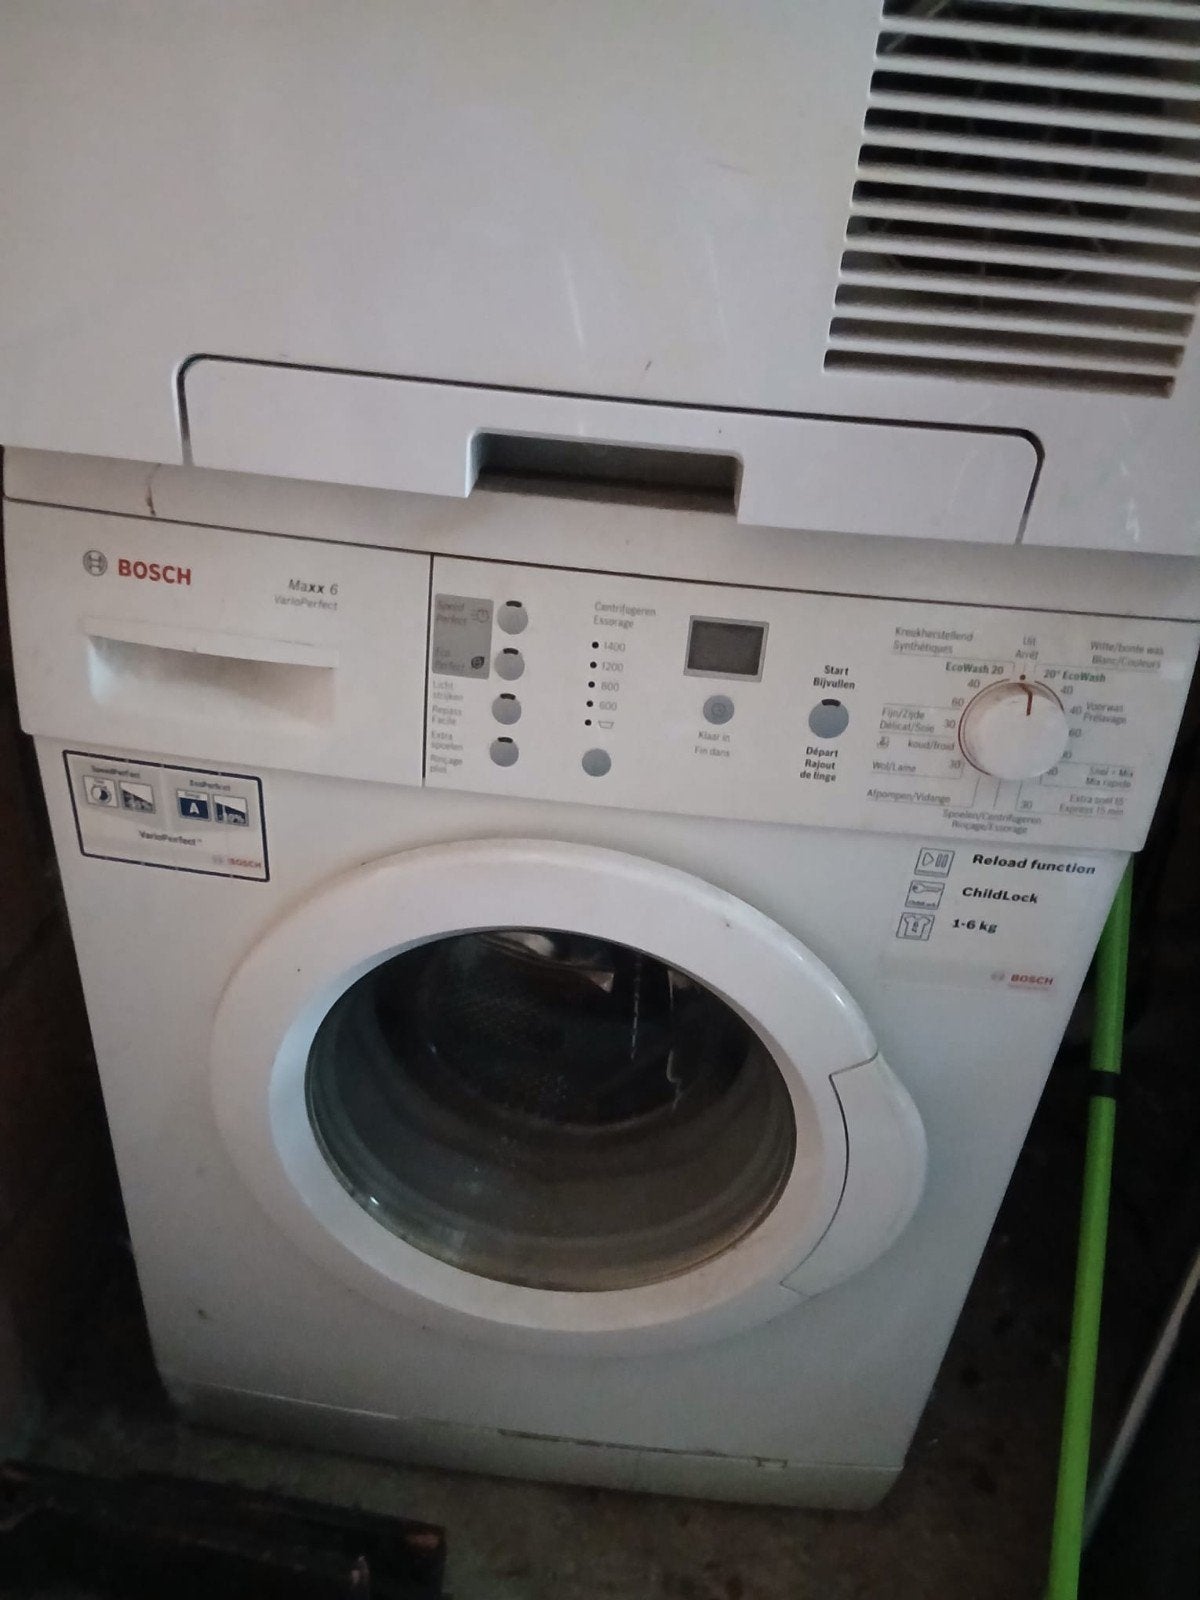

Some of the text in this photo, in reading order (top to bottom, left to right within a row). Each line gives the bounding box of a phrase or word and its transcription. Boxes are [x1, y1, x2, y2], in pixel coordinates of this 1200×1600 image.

[117, 558, 192, 586] BOSCH
[289, 578, 339, 596] Maxx 6
[274, 594, 339, 611] VarioPerfect
[594, 600, 657, 616] Centrifugeren
[593, 615, 634, 629] Essorage
[603, 641, 626, 653] 1400
[601, 660, 624, 673] 1200
[824, 664, 849, 676] Start
[945, 661, 990, 674] EcoWash
[1062, 670, 1106, 683] EcoWash
[600, 681, 620, 693] 800
[813, 677, 856, 691] Bijvullen
[967, 678, 981, 689] 40
[1060, 684, 1074, 695] 40
[599, 700, 618, 712] 600
[697, 730, 721, 741] Klaar
[805, 746, 839, 758] Départ
[804, 759, 836, 771] Rajout
[799, 770, 837, 783] de linge
[972, 853, 1097, 875] Reload function
[961, 886, 1040, 904] ChildLock
[951, 918, 998, 934] 1-6 kg
[1010, 973, 1054, 986] BOSCH
